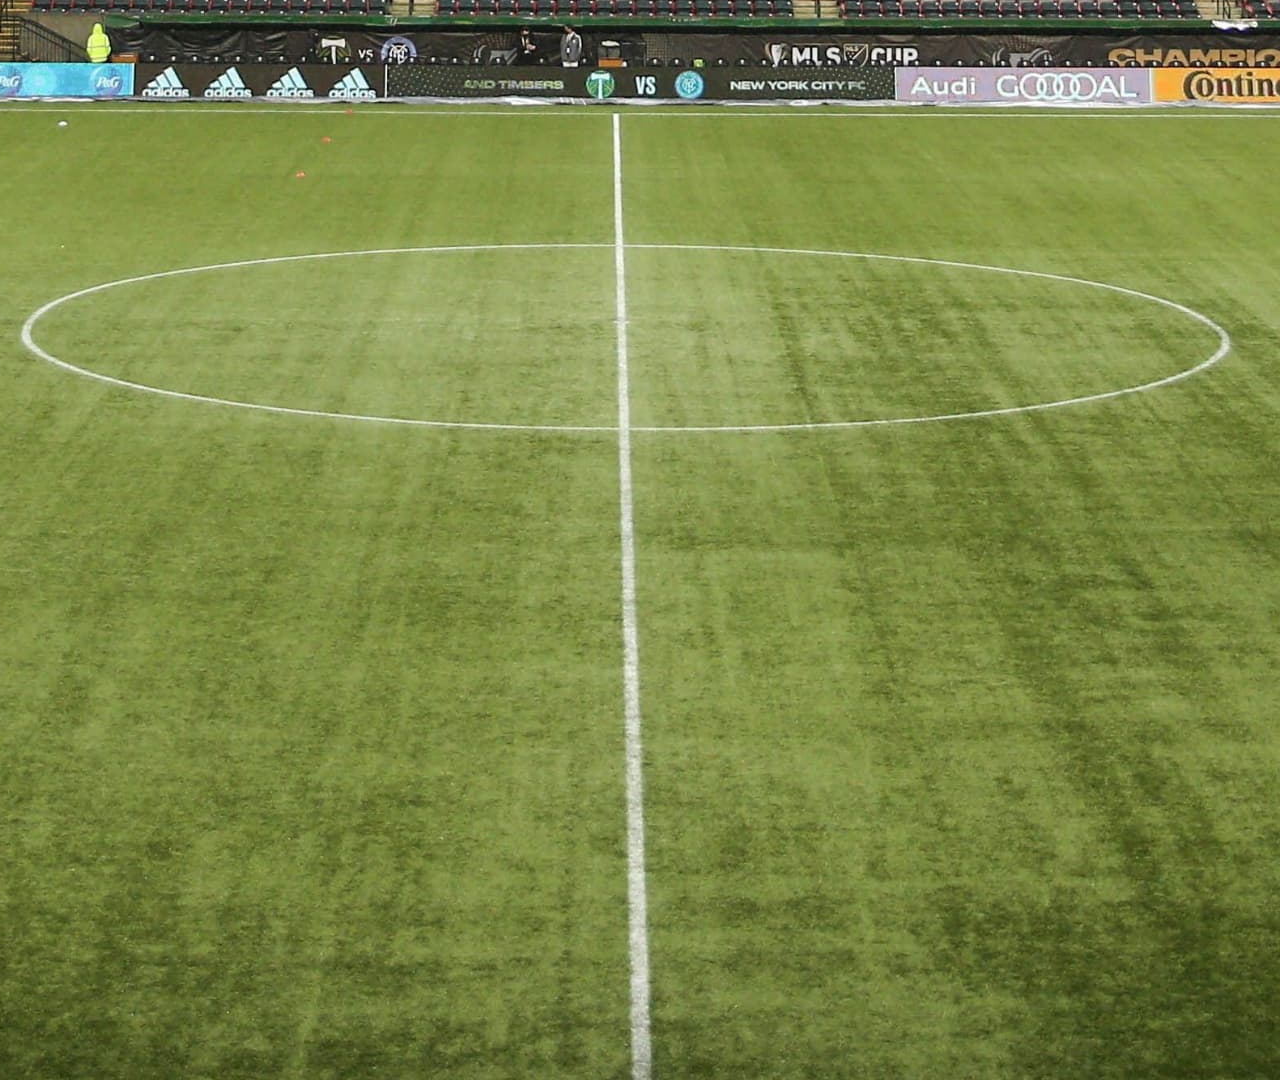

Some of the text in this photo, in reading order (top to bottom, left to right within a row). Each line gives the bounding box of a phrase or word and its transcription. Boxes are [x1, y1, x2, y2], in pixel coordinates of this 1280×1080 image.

[792, 47, 919, 66] MLS CUP
[96, 75, 120, 88] P&G
[636, 75, 656, 95] VS
[730, 81, 866, 91] NEW YORK CITY FC
[911, 77, 975, 95] Audi
[142, 87, 189, 97] adidas
[204, 87, 252, 97] adidas
[266, 87, 314, 97] adidas
[328, 87, 376, 97] adidas
